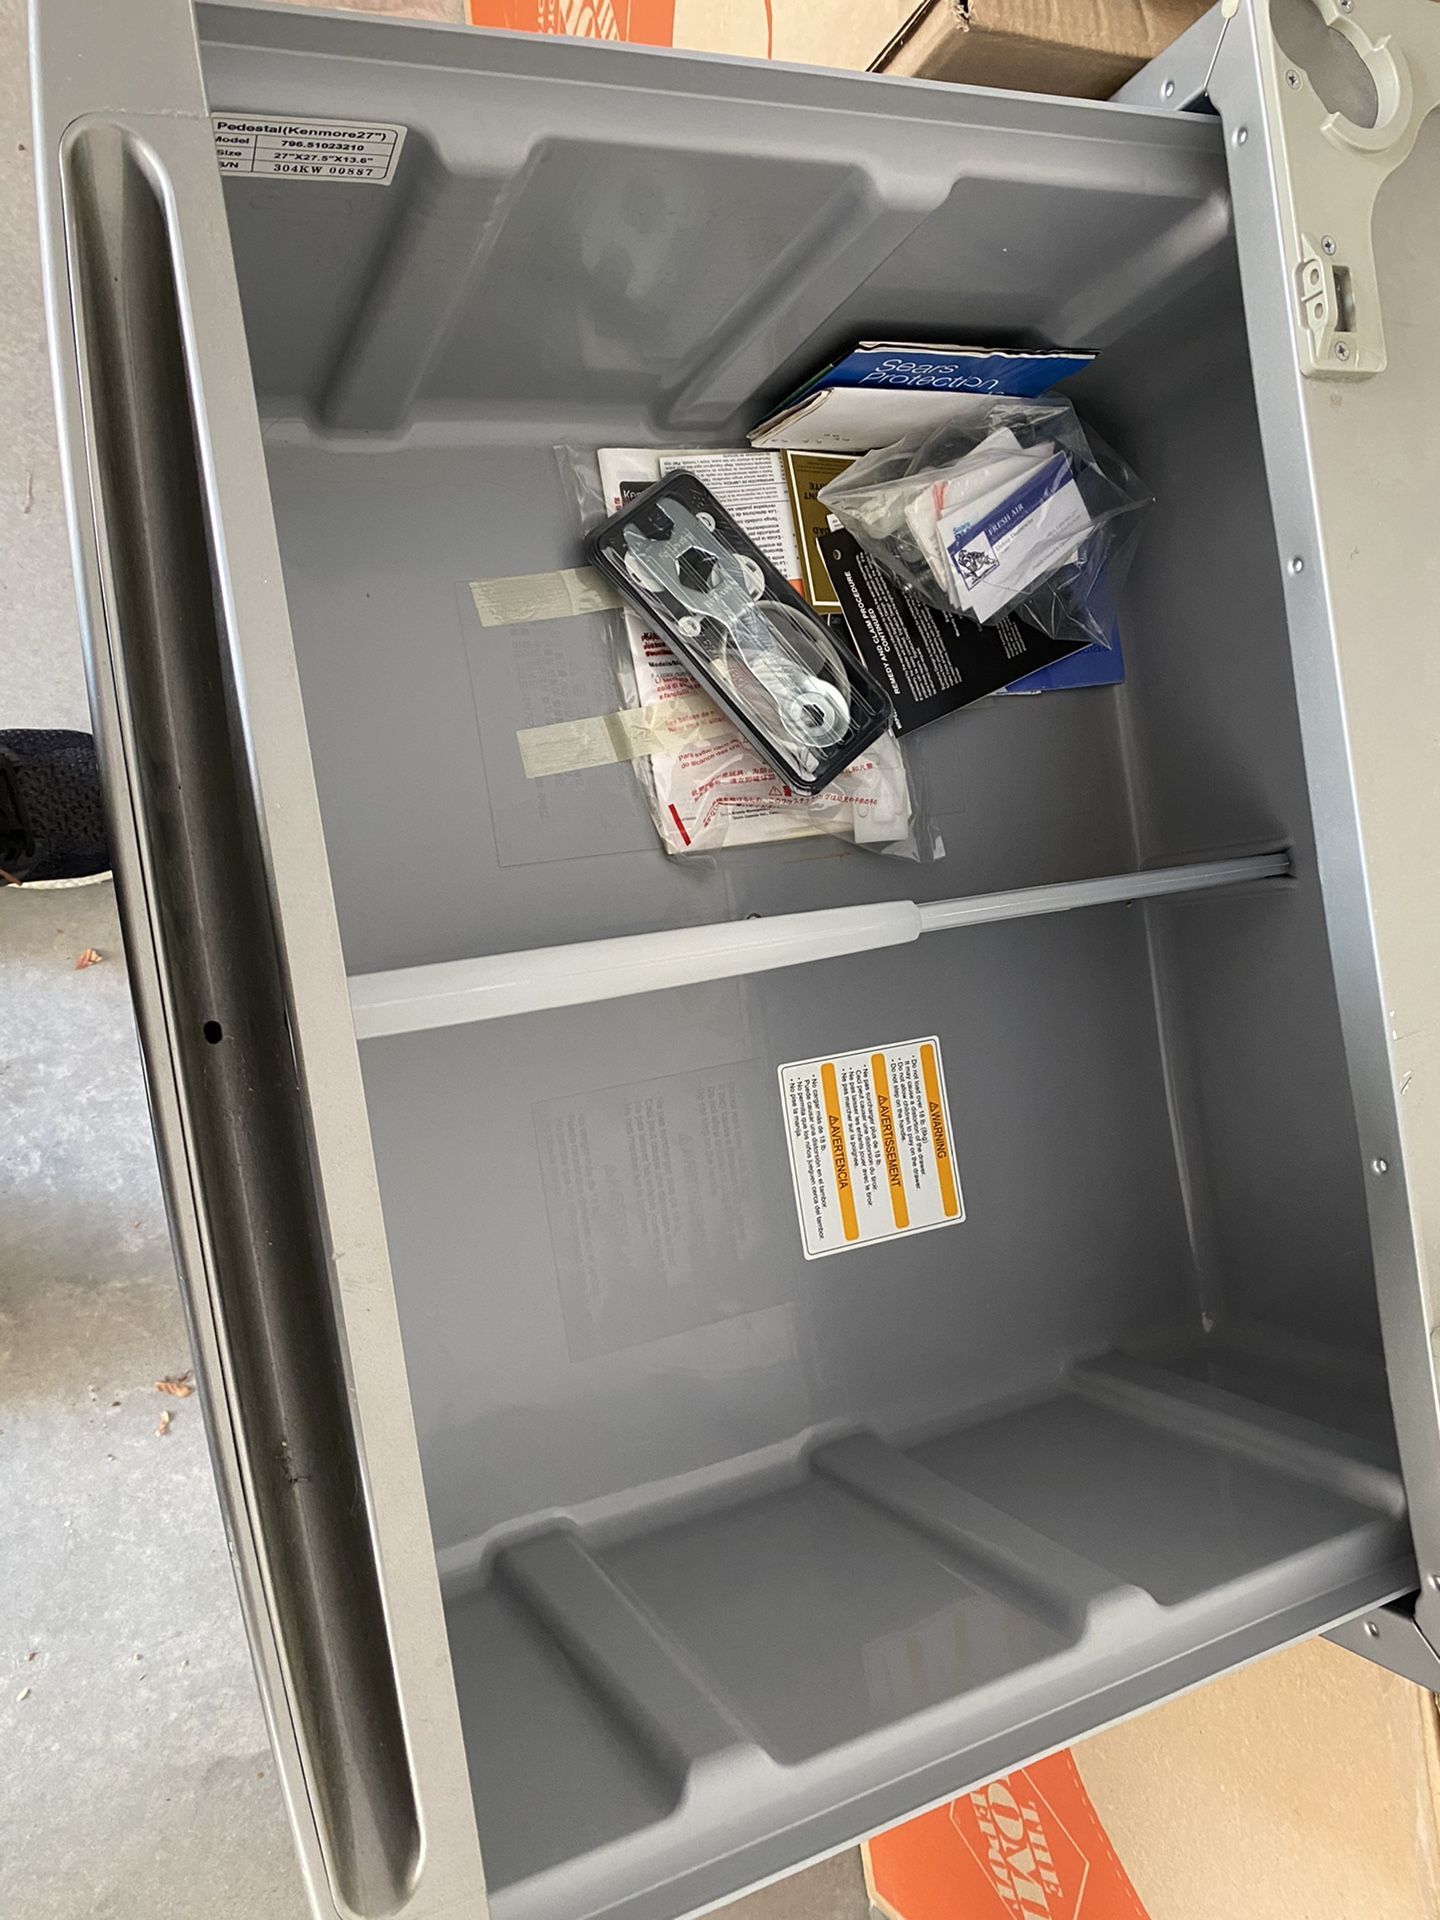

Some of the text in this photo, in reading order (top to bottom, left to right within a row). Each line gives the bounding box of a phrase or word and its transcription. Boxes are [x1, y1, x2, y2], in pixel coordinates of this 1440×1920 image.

[217, 121, 387, 141] Pedestal(Kenmore27")
[217, 149, 242, 157] Size
[281, 140, 365, 151] 796.51023210
[273, 164, 374, 176] 304KW 00887
[875, 358, 959, 374] Sears
[858, 372, 999, 390] Protection
[987, 515, 1012, 535] FRESH
[1011, 503, 1025, 517] AIR
[844, 570, 867, 619] PROCEDURE
[866, 620, 879, 644] CLAIM
[868, 608, 890, 652] CONTINUED
[876, 645, 887, 662] AND
[883, 662, 900, 694] REMEDY
[879, 1104, 900, 1187] AVERTISSEMENT
[931, 1110, 946, 1159] WARNING
[830, 1125, 848, 1189] AVERTENCIA
[1020, 1801, 1064, 1898] THE
